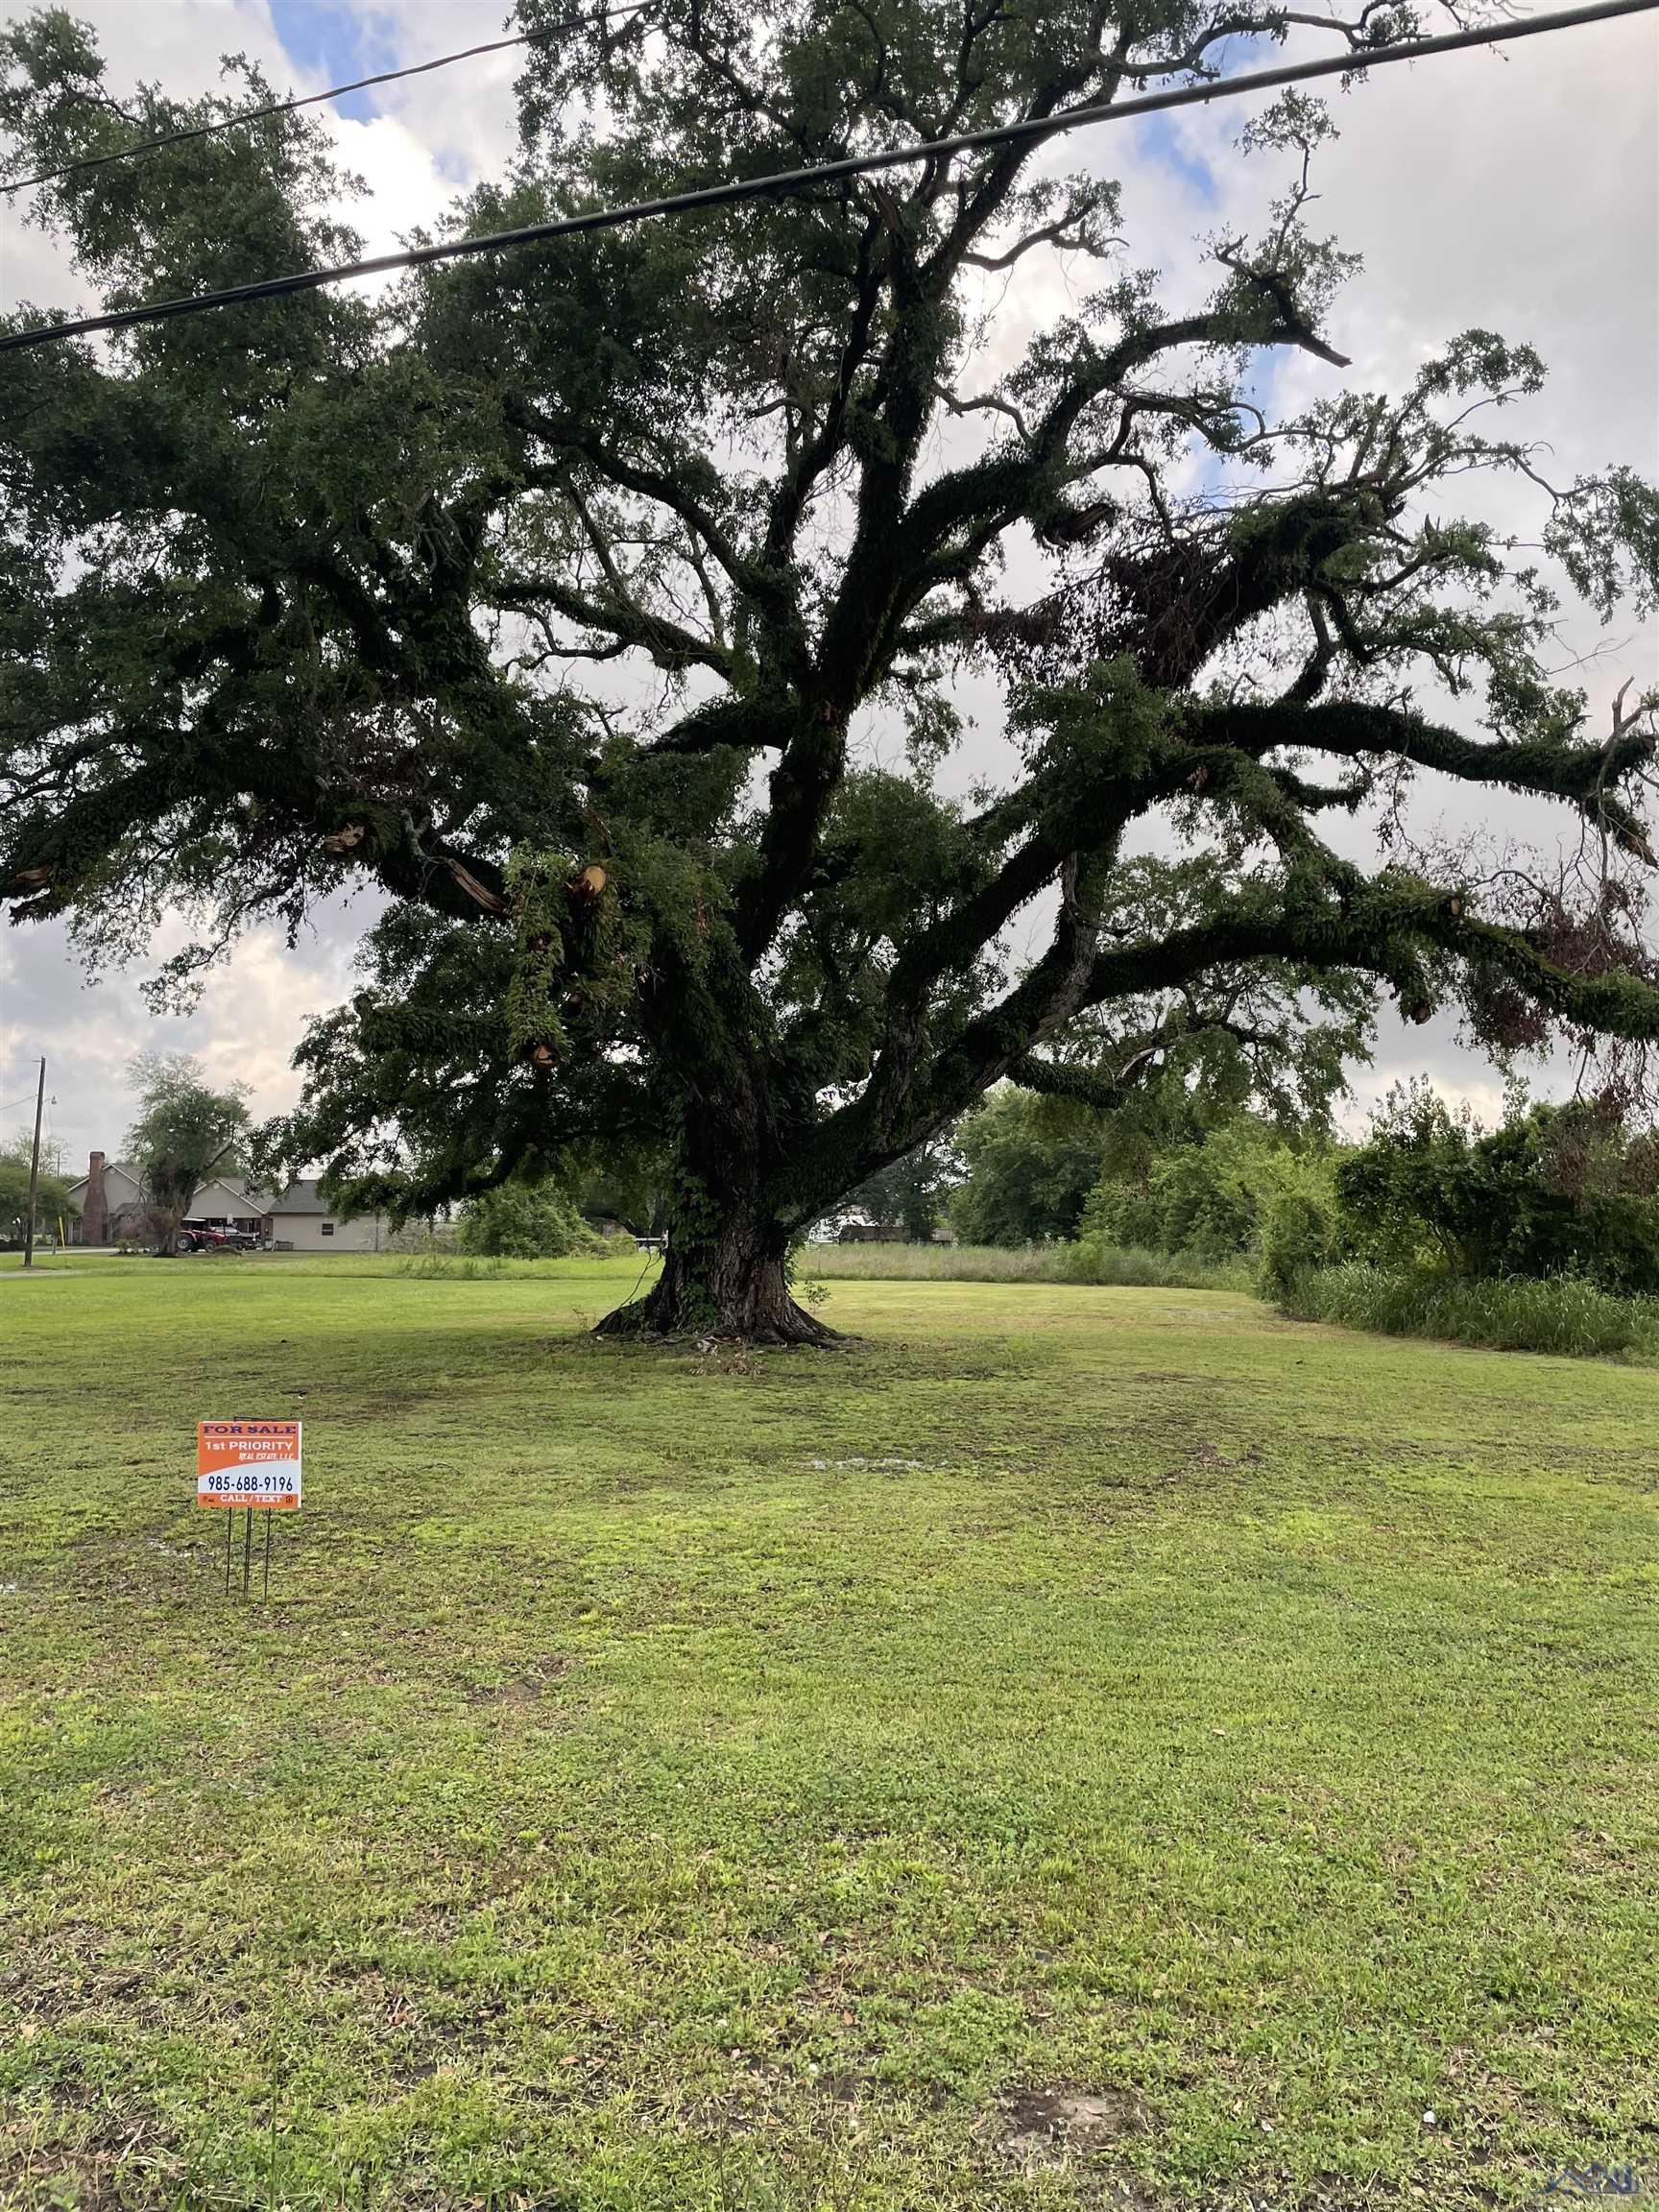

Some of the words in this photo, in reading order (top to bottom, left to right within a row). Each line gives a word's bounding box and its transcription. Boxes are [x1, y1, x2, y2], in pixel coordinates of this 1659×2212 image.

[204, 1426, 243, 1434] FOR
[247, 1426, 297, 1434] SALE
[204, 1441, 226, 1451] 1st
[228, 1441, 293, 1451] PRIORITY
[208, 1476, 293, 1491] 985-688-9196
